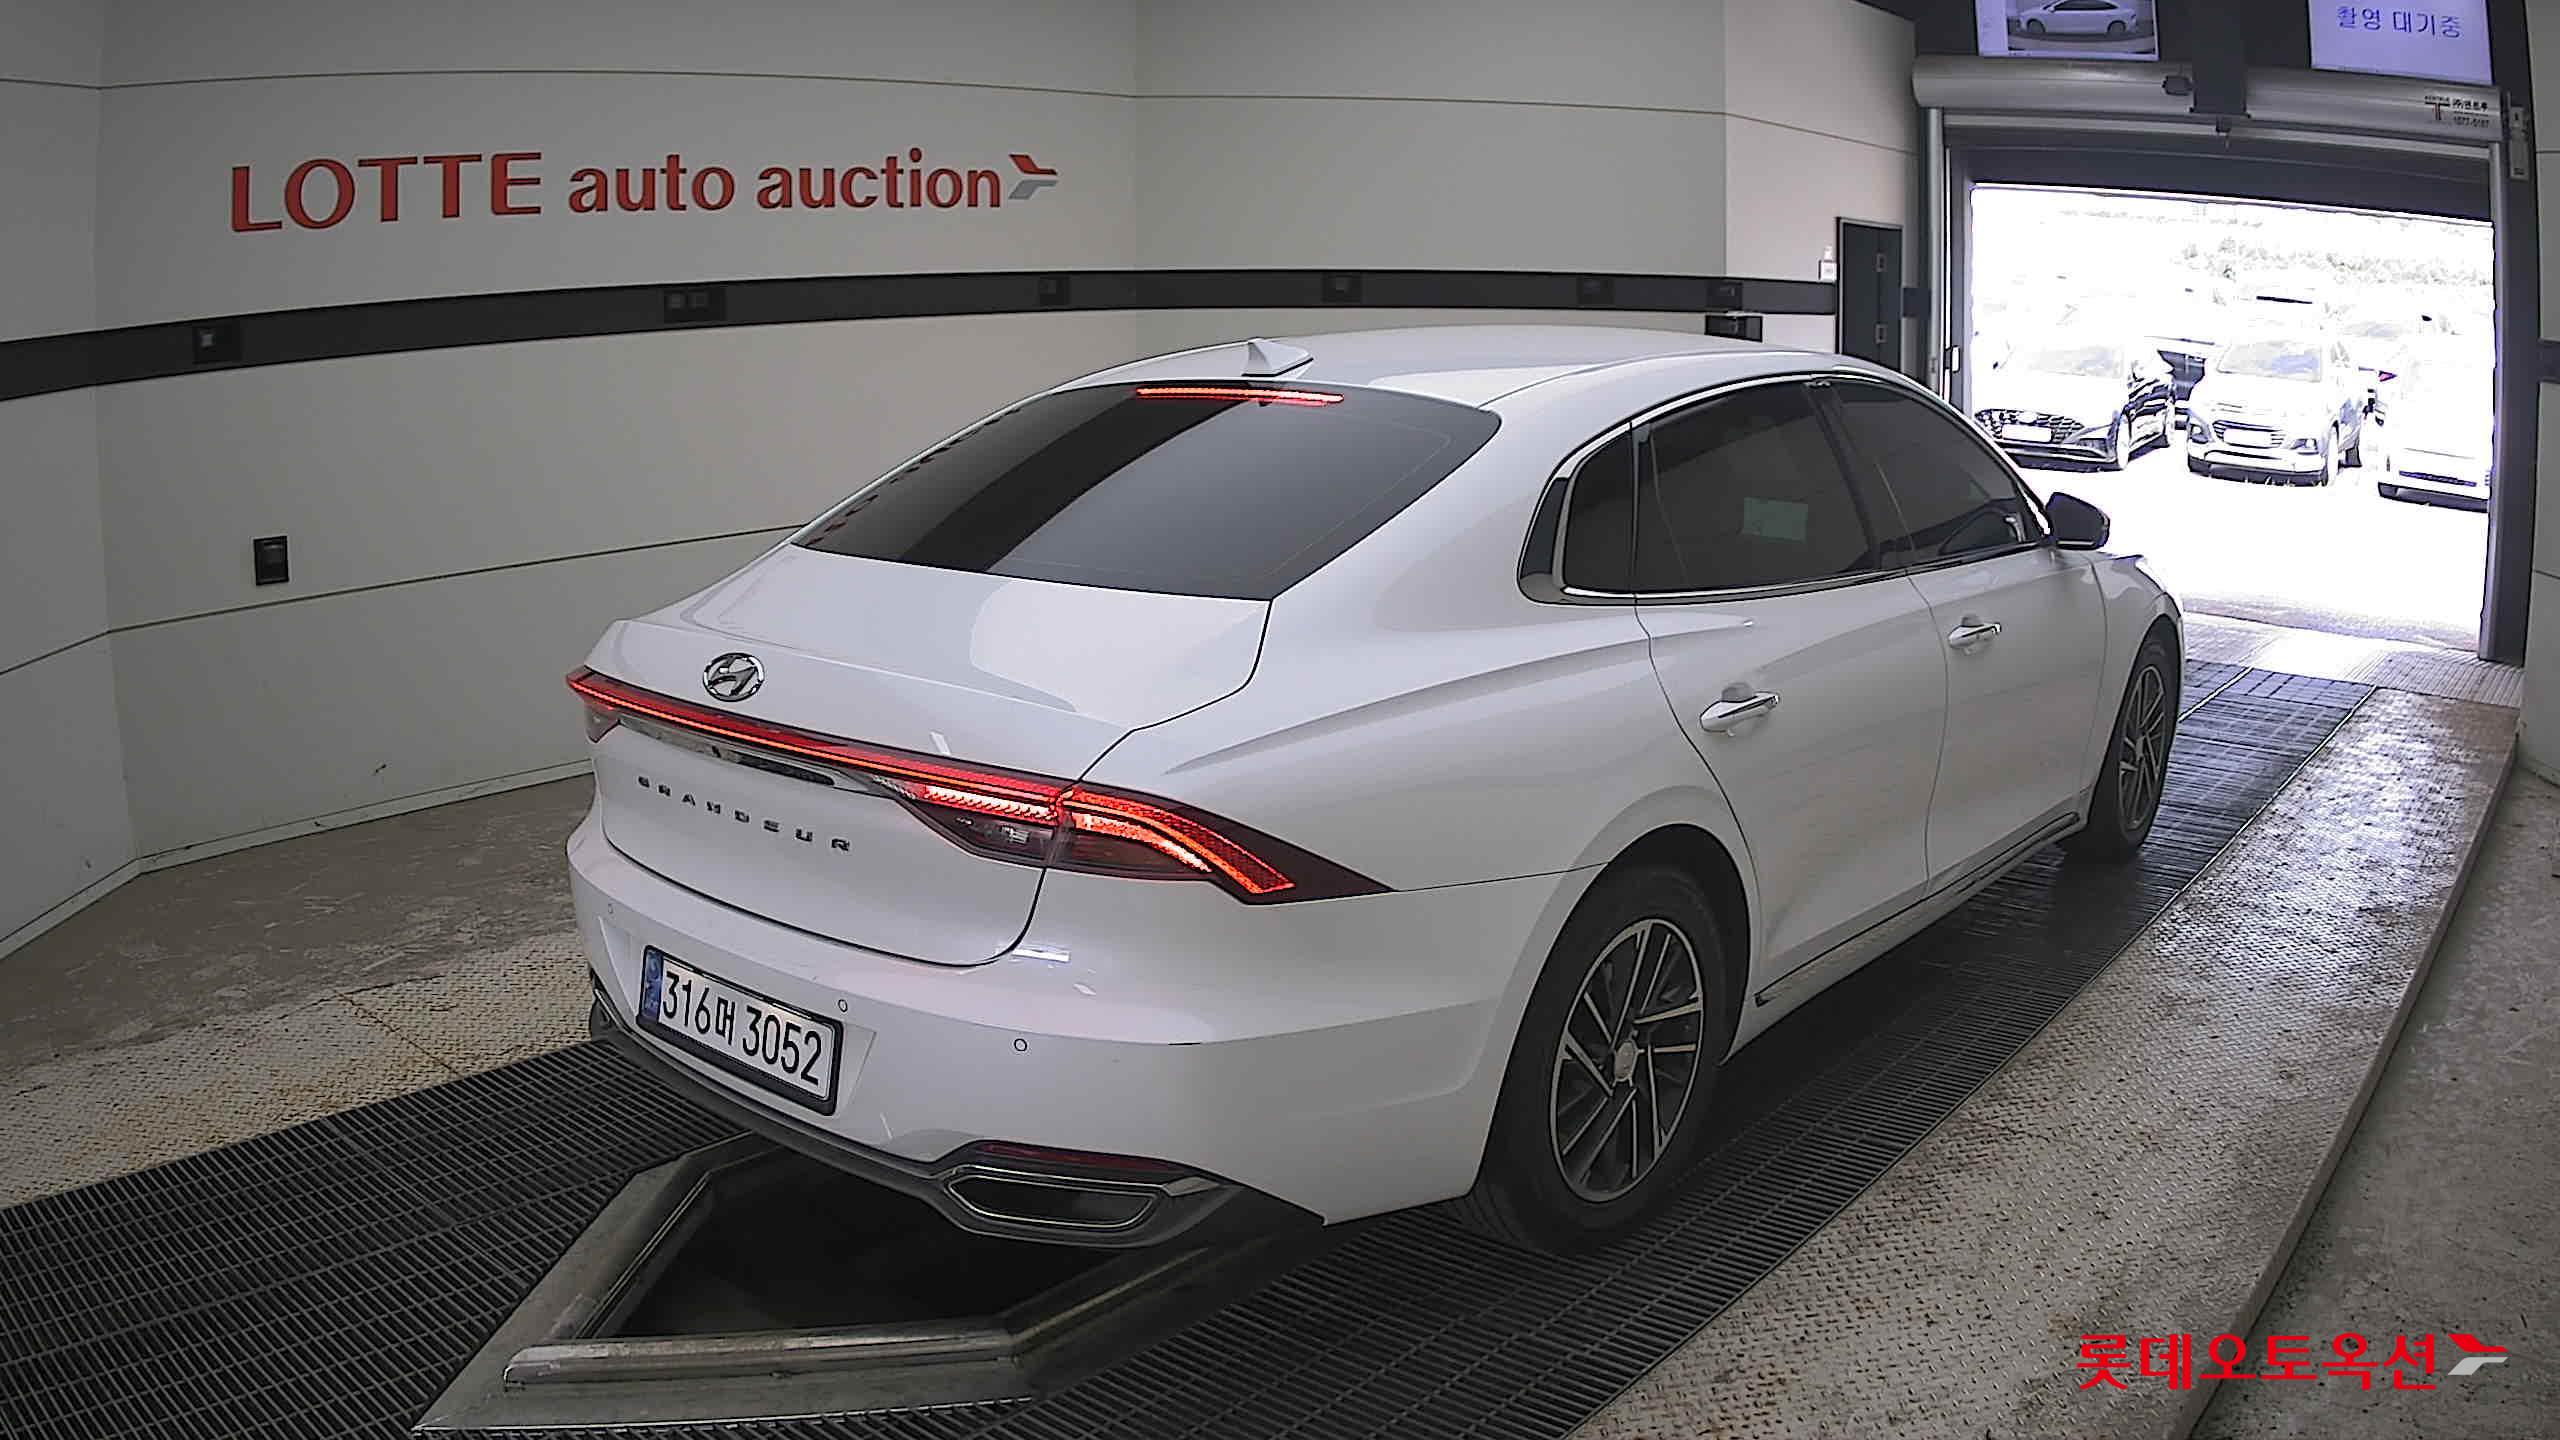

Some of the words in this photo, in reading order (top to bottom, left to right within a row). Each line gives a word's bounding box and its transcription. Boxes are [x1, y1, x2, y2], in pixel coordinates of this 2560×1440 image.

[2337, 6, 2382, 31] 촬영
[2392, 10, 2462, 39] 대기중
[231, 152, 540, 233] LOTTE
[569, 153, 737, 213] auto
[756, 148, 1002, 210] auction
[637, 775, 851, 853] GRANDEUR
[662, 970, 736, 1046] 316머
[742, 1005, 822, 1086] 3052
